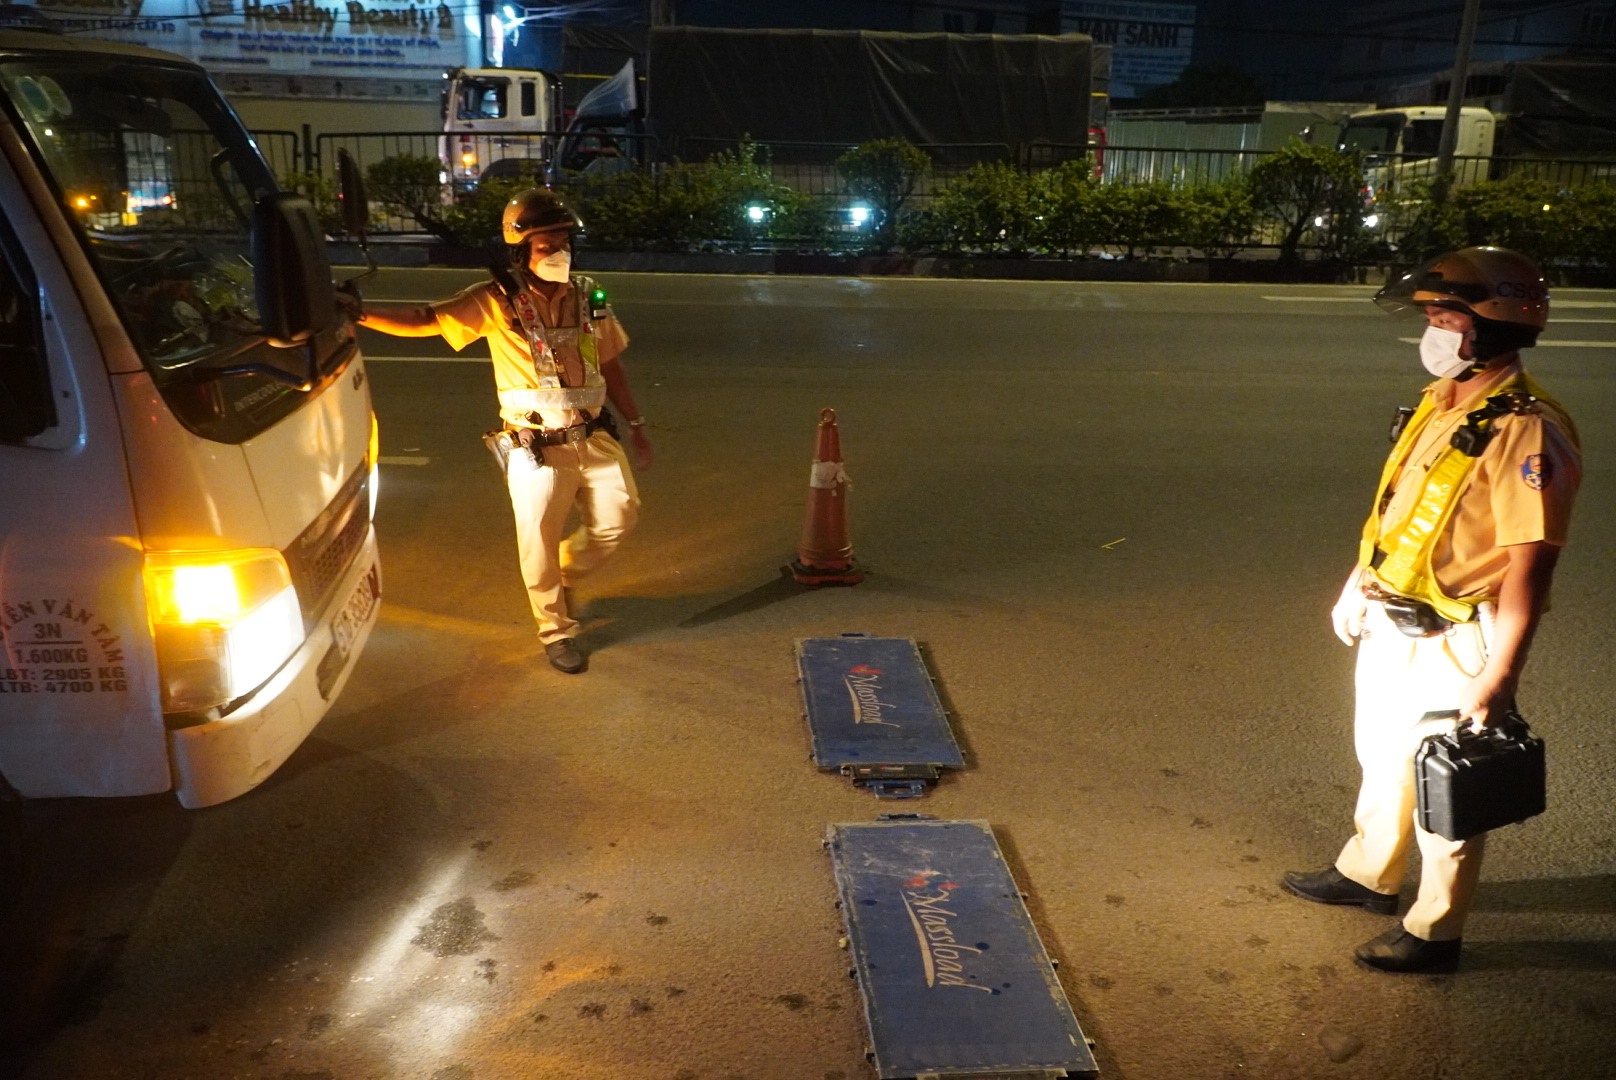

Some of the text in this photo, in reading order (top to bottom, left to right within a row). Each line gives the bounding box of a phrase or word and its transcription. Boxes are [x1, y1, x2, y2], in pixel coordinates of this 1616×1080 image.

[243, 0, 338, 34] Healthy
[346, 1, 434, 37] Beauty
[34, 623, 62, 639] 3N
[14, 648, 88, 664] 1.600KG
[43, 667, 91, 680] 2905
[98, 666, 125, 679] KG
[45, 681, 94, 693] 4700
[101, 679, 128, 692] KG
[906, 888, 993, 994] Massload
